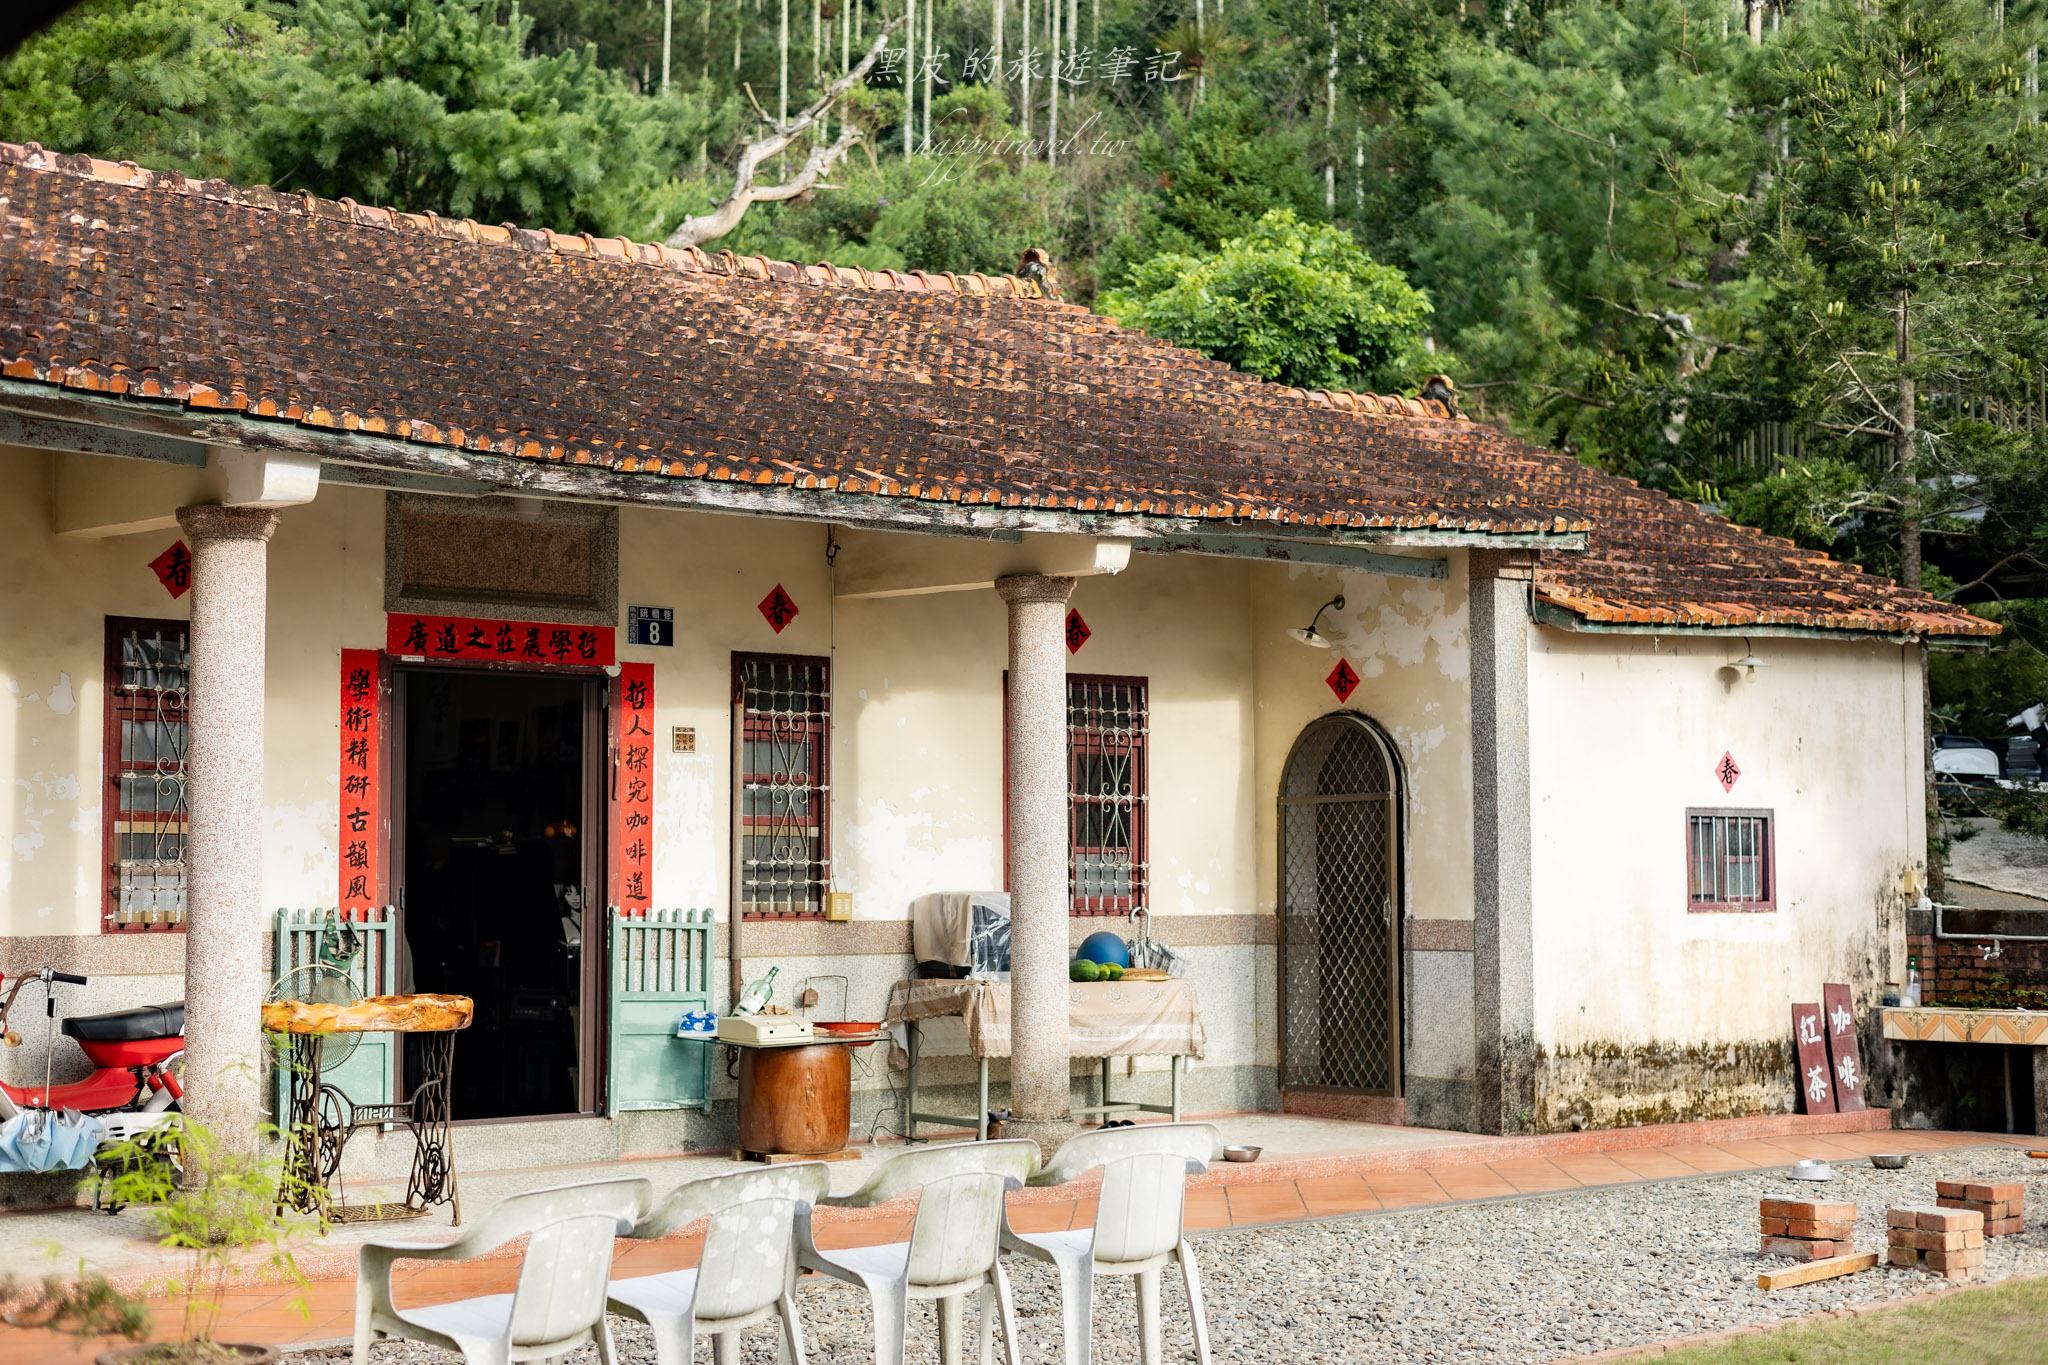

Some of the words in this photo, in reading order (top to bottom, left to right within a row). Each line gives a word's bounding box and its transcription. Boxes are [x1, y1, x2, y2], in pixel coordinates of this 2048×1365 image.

[165, 547, 191, 587] 春
[768, 594, 793, 626] 春
[649, 621, 660, 645] 8
[1065, 614, 1088, 647] 春
[1334, 664, 1354, 693] 春
[1721, 756, 1739, 784] 春
[624, 679, 651, 900] 哲人探究咖啡道
[1800, 1015, 1828, 1103] 紅茶
